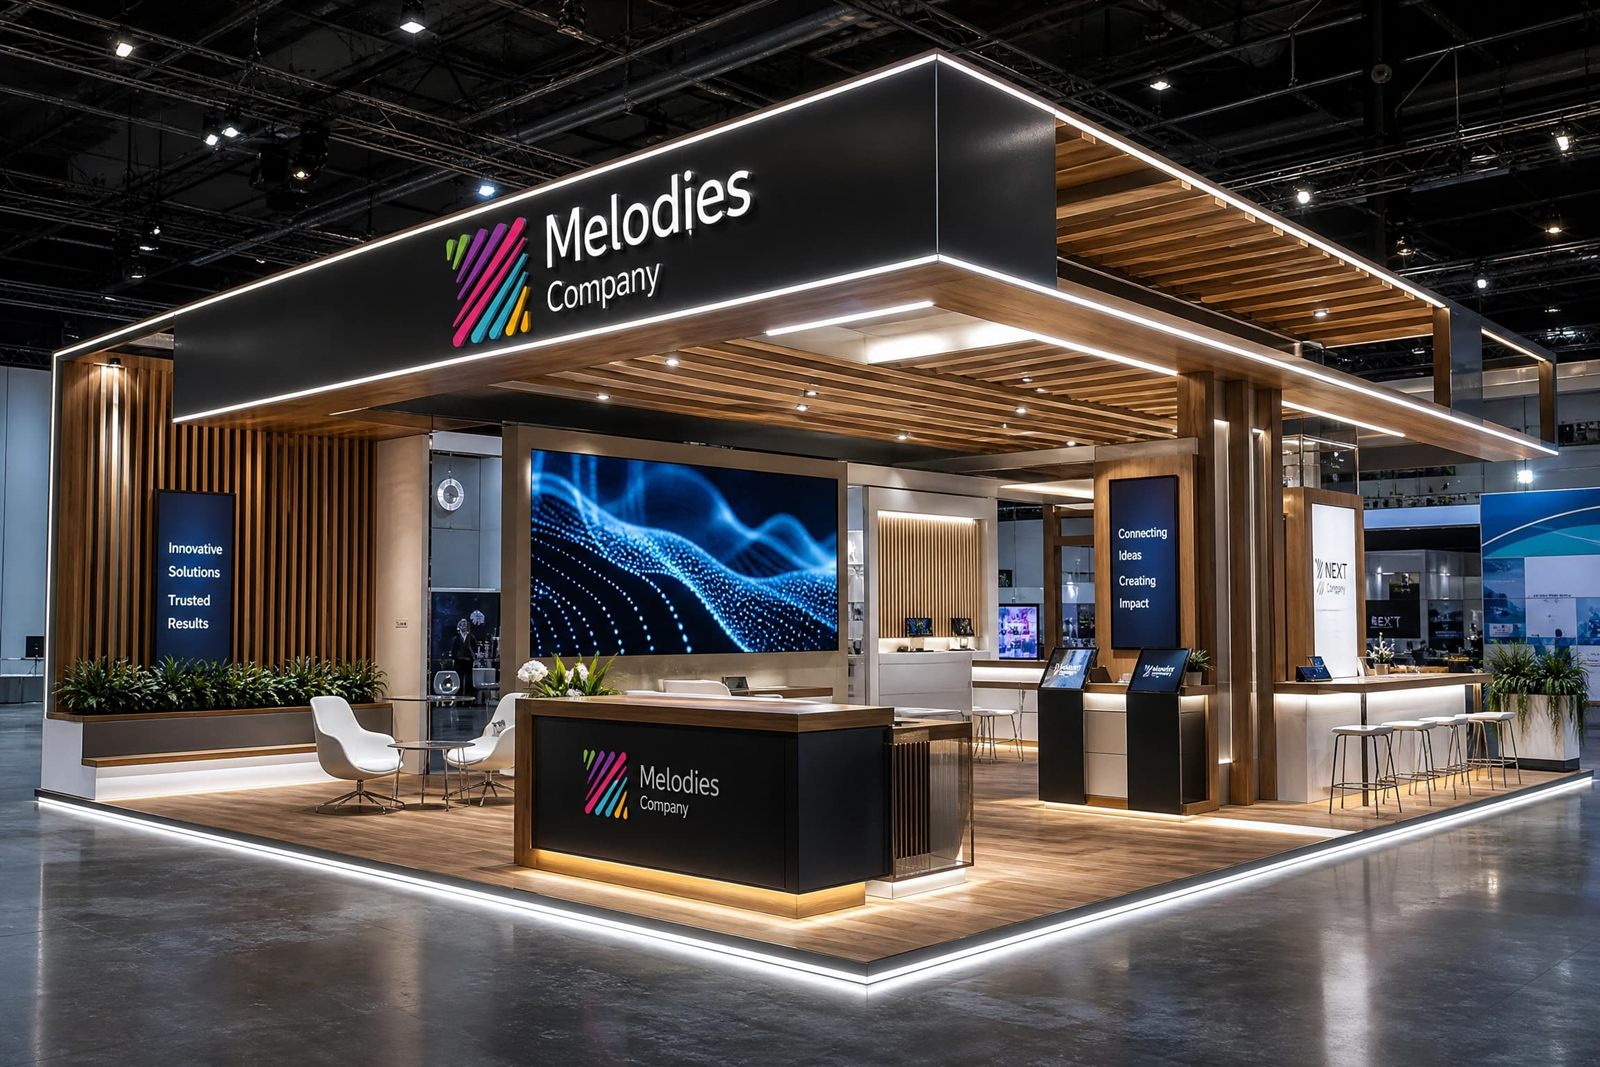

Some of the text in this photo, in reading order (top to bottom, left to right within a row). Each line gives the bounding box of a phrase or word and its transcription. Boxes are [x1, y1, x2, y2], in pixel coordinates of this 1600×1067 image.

[545, 169, 752, 269] Melodies
[546, 262, 663, 312] Company
[1118, 527, 1168, 540] Connecting
[168, 541, 223, 555] Innovative
[1118, 550, 1142, 561] Ideas
[168, 565, 221, 578] Solutions
[1325, 562, 1348, 579] NEXT
[1119, 575, 1156, 588] Creating
[167, 594, 211, 607] Trusted
[1119, 598, 1150, 611] Impact
[167, 617, 209, 629] Results
[640, 764, 720, 797] Melodies
[640, 795, 689, 819] Company
